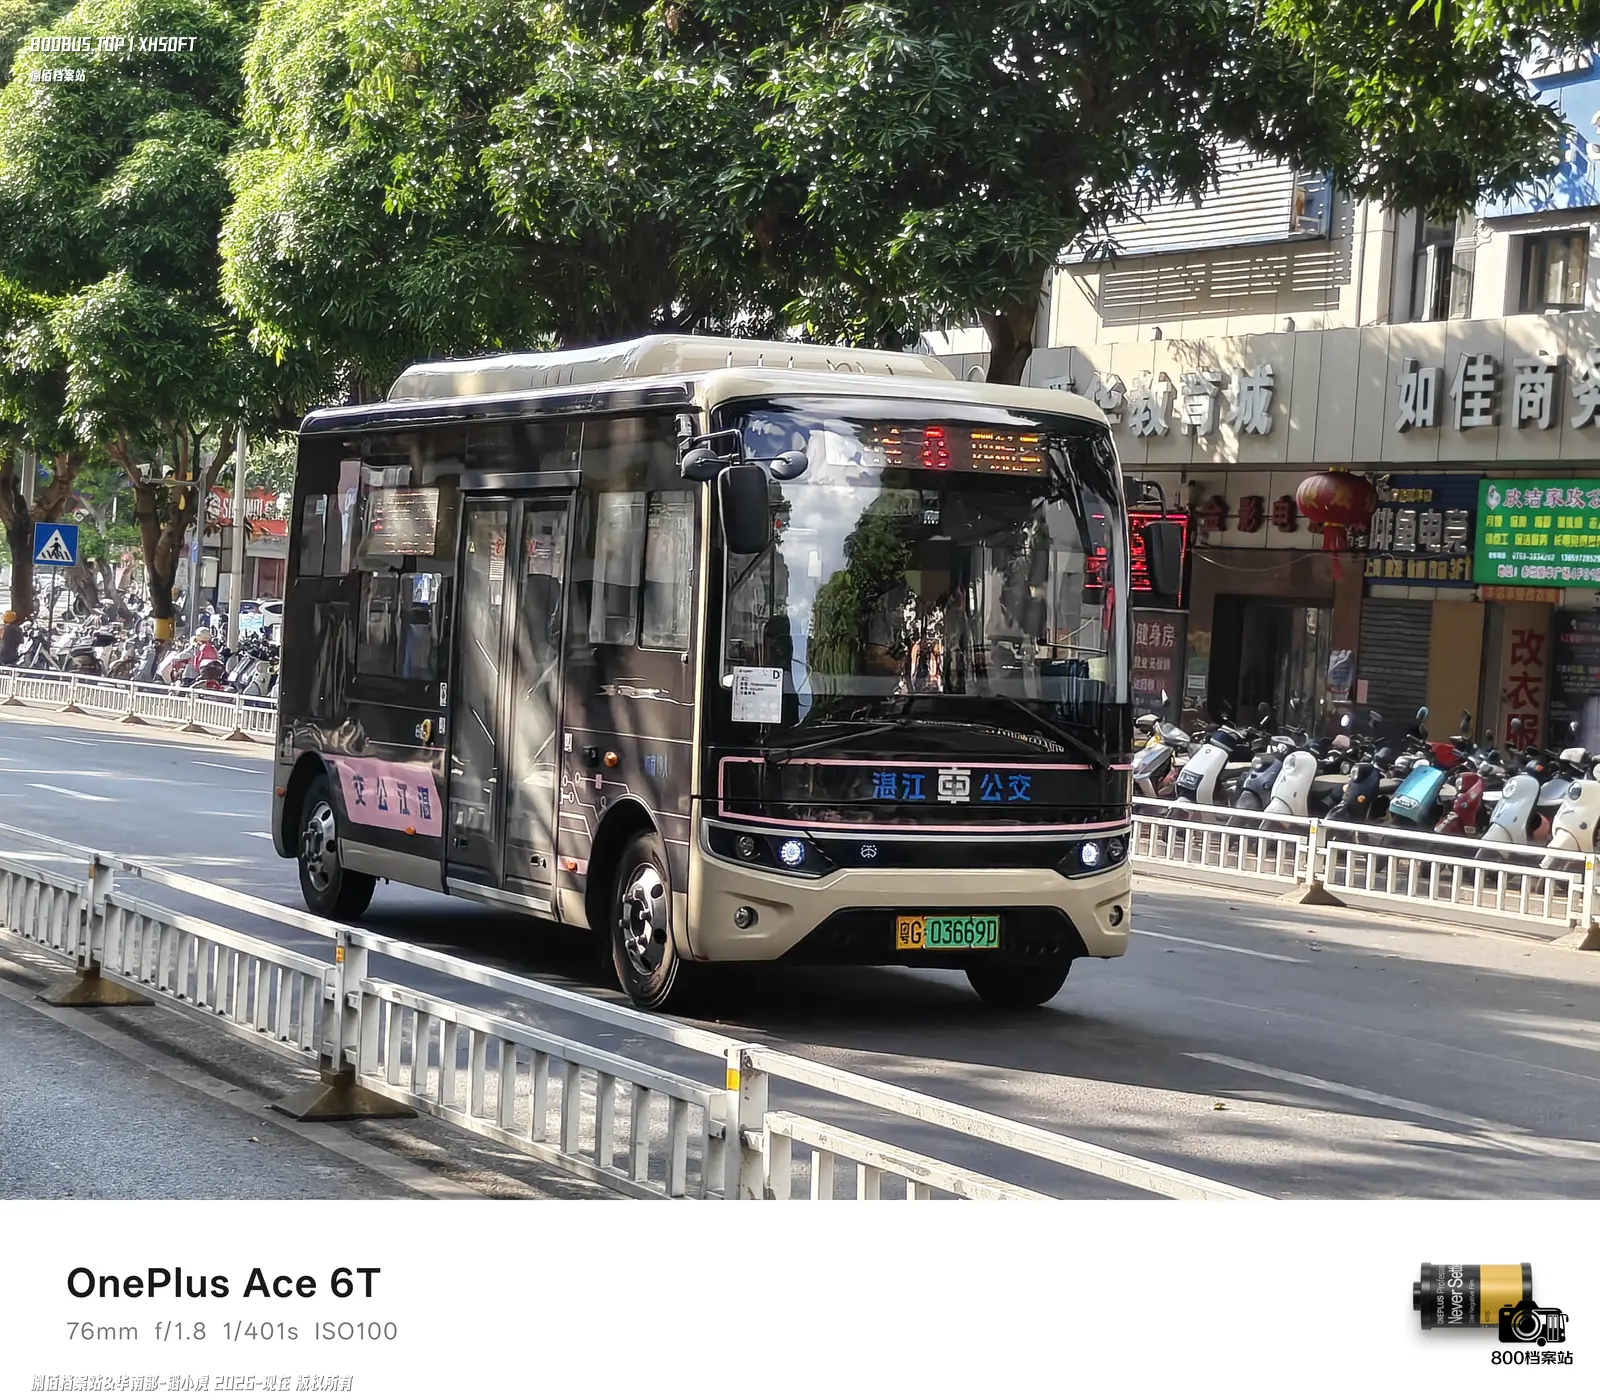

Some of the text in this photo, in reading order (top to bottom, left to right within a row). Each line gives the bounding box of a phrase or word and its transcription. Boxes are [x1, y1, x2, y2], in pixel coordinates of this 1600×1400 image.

[1046, 363, 1274, 437] 华教育城
[773, 670, 780, 680] D
[872, 771, 926, 800] 湛江
[980, 773, 1032, 801] 公交
